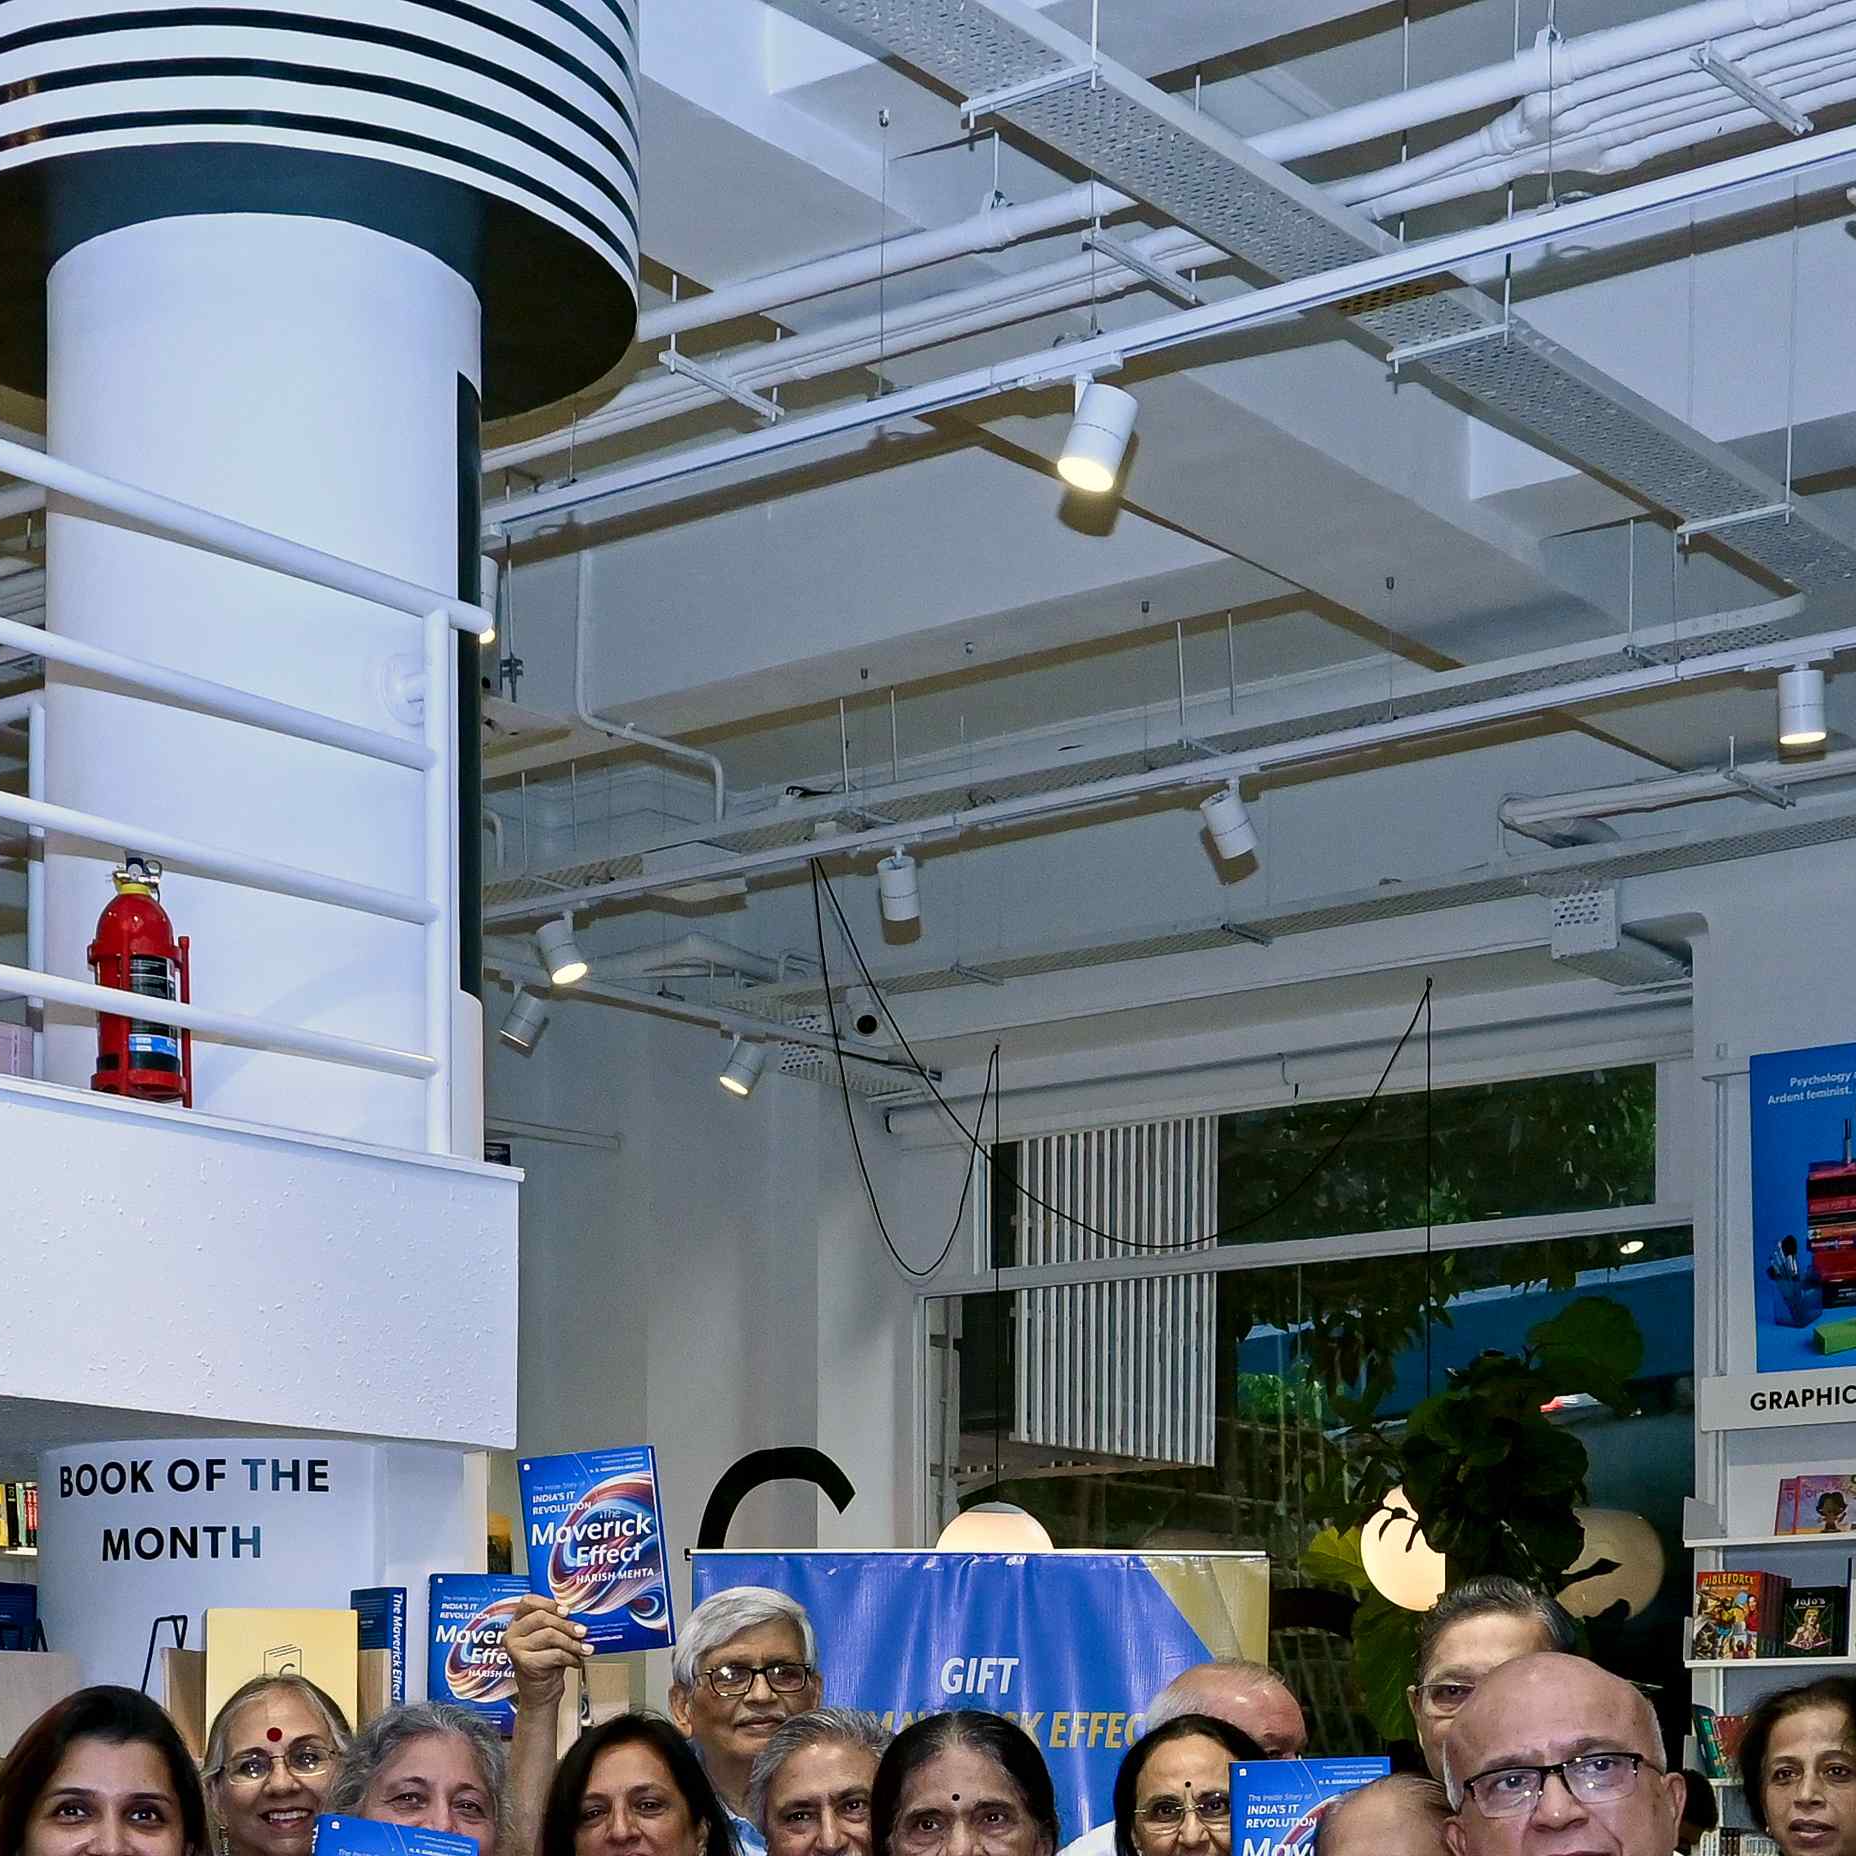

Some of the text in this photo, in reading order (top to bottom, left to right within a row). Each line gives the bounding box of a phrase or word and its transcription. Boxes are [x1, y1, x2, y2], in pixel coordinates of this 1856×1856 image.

[1767, 1092, 1805, 1105] Ardent
[1806, 1086, 1853, 1100] feminist.
[1790, 1071, 1852, 1088] Psychology
[60, 1458, 330, 1498] BOOK OF THE
[102, 1525, 262, 1562] MONTH
[532, 1512, 652, 1545] Maverick
[577, 1542, 642, 1567] Effect
[393, 1593, 403, 1612] The
[391, 1615, 404, 1666] Maverick
[435, 1624, 505, 1648] Maver
[941, 1656, 1020, 1695] GIFT
[1048, 1711, 1145, 1749] EFFEC
